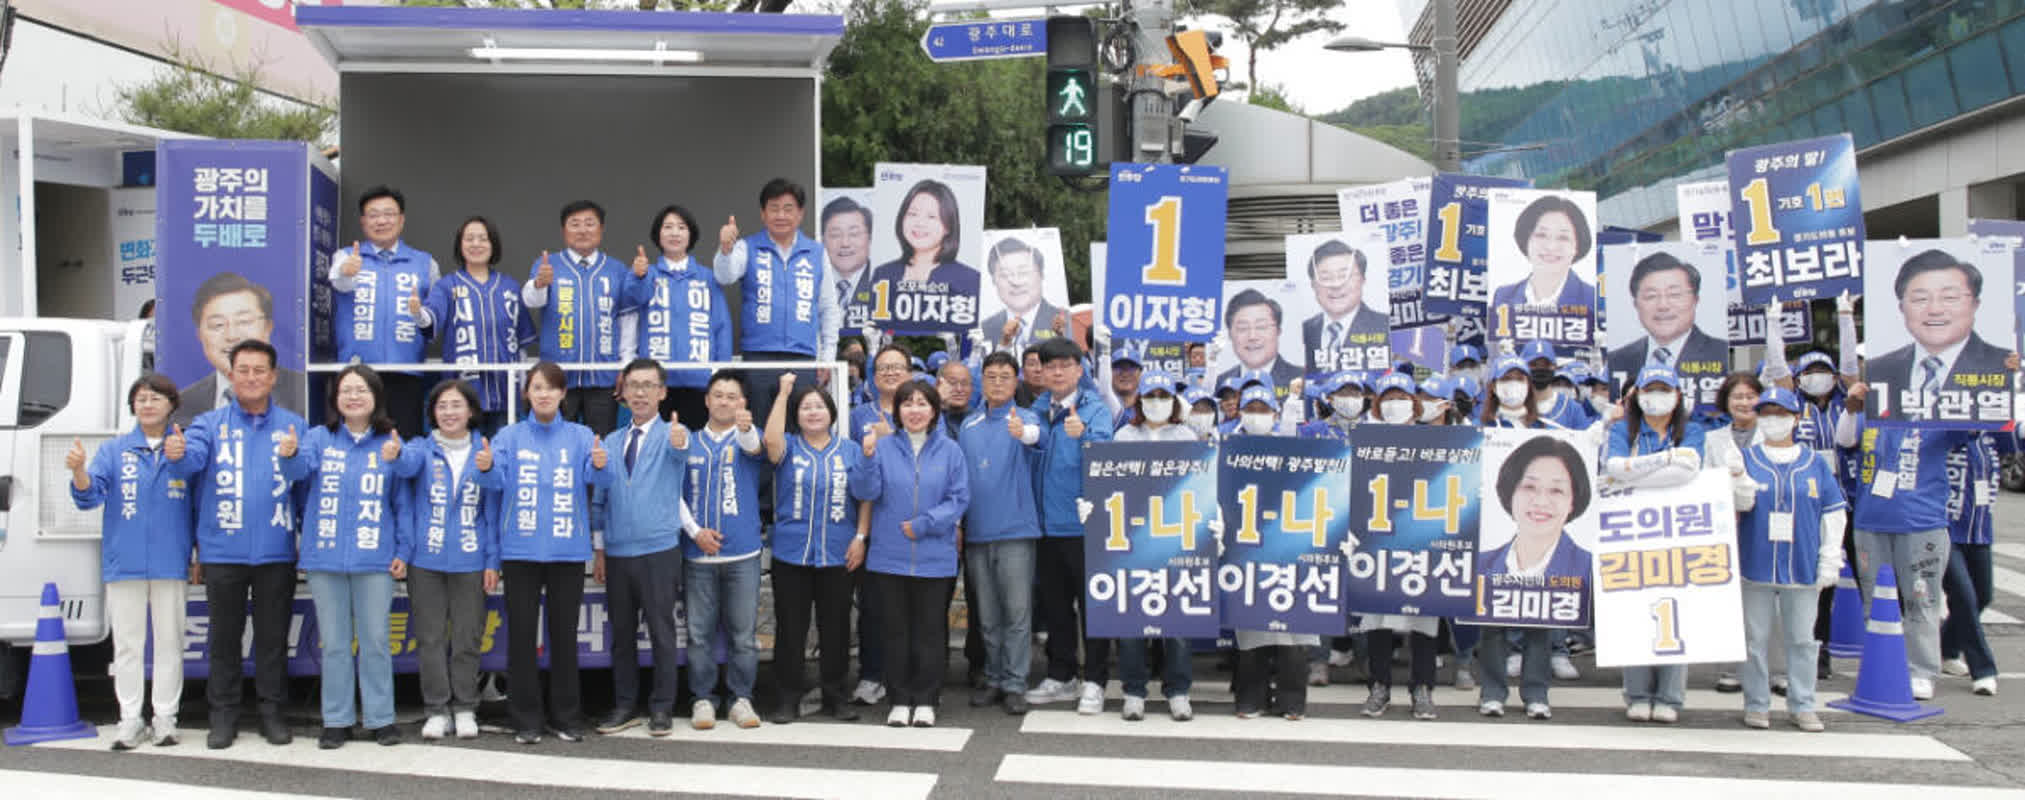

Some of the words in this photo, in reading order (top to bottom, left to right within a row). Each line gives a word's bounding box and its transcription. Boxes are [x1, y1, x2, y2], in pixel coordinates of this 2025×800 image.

[968, 23, 1032, 42] 광주대로
[1066, 130, 1093, 165] 19
[1755, 153, 1798, 173] 광주의
[193, 167, 268, 193] 광주의
[193, 195, 268, 221] 가치를
[1360, 203, 1379, 224] 더
[1384, 198, 1418, 221] 좋은
[1434, 201, 1464, 263] 1
[1741, 177, 1781, 246] 1
[1778, 195, 1804, 211] 기호
[1806, 181, 1846, 213] 1번
[193, 223, 268, 249] 두배로
[1142, 195, 1187, 287] 1
[1390, 243, 1425, 266] 좋은
[755, 250, 772, 324] 국회의원
[1745, 239, 1863, 288] 최보라
[558, 287, 575, 349] 광주시장
[648, 286, 671, 360] 시의원
[687, 288, 711, 363] 이은채
[871, 279, 892, 321] 1
[895, 293, 977, 325] 이자형
[1109, 293, 1216, 335] 이자형
[1495, 303, 1511, 337] 1
[1515, 315, 1588, 342] 김미경
[454, 298, 480, 380] 시의원
[1314, 345, 1390, 372] 박관열
[1901, 388, 2012, 422] 박관열
[1953, 373, 2005, 388] 직통시장
[216, 440, 244, 529] 시의원
[368, 452, 377, 469] 1
[1226, 455, 1284, 472] 나의선택!
[121, 463, 138, 521] 오현주
[318, 475, 340, 539] 도의원
[357, 473, 385, 550] 이자형
[517, 465, 538, 531] 도의원
[553, 466, 573, 539] 최보라
[1367, 473, 1468, 535] 1-나
[1807, 477, 1819, 498] 1
[459, 480, 481, 553] 김미경
[1104, 490, 1202, 551] 1-나
[1236, 483, 1335, 548] 1-나
[1598, 502, 1714, 543] 도의원
[1088, 567, 1213, 617] 이경선
[1217, 561, 1340, 614] 이경선
[1349, 549, 1473, 597] 이경선
[1599, 543, 1734, 593] 김미경
[1492, 588, 1581, 622] 김미경
[1650, 596, 1686, 656] 1
